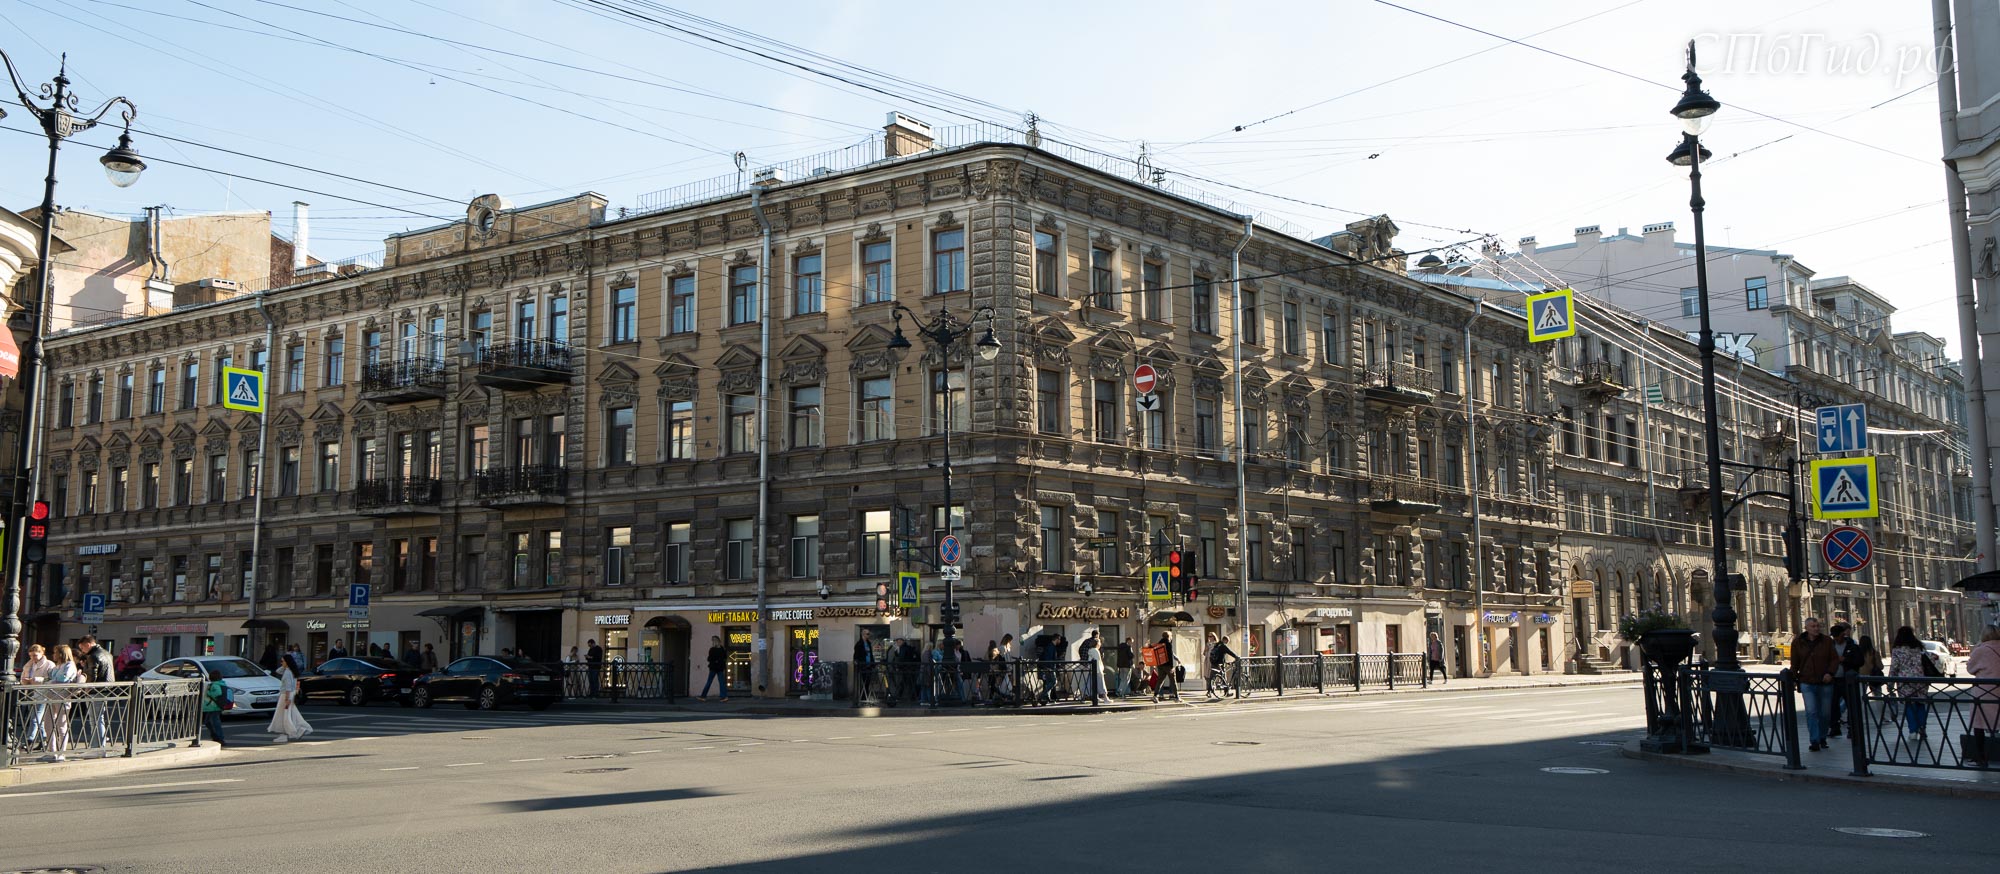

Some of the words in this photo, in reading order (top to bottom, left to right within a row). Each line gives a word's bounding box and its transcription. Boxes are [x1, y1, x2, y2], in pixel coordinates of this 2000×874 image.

[776, 610, 792, 620] PRICE
[792, 609, 813, 620] COFFEE
[816, 606, 876, 617] Булочная
[1038, 602, 1109, 619] Булочная
[1119, 606, 1130, 618] 31
[1317, 607, 1353, 618] ПРОДУКТЫ
[597, 615, 612, 625] PRICE
[612, 614, 630, 624] COFFEE
[730, 633, 752, 643] VAPE
